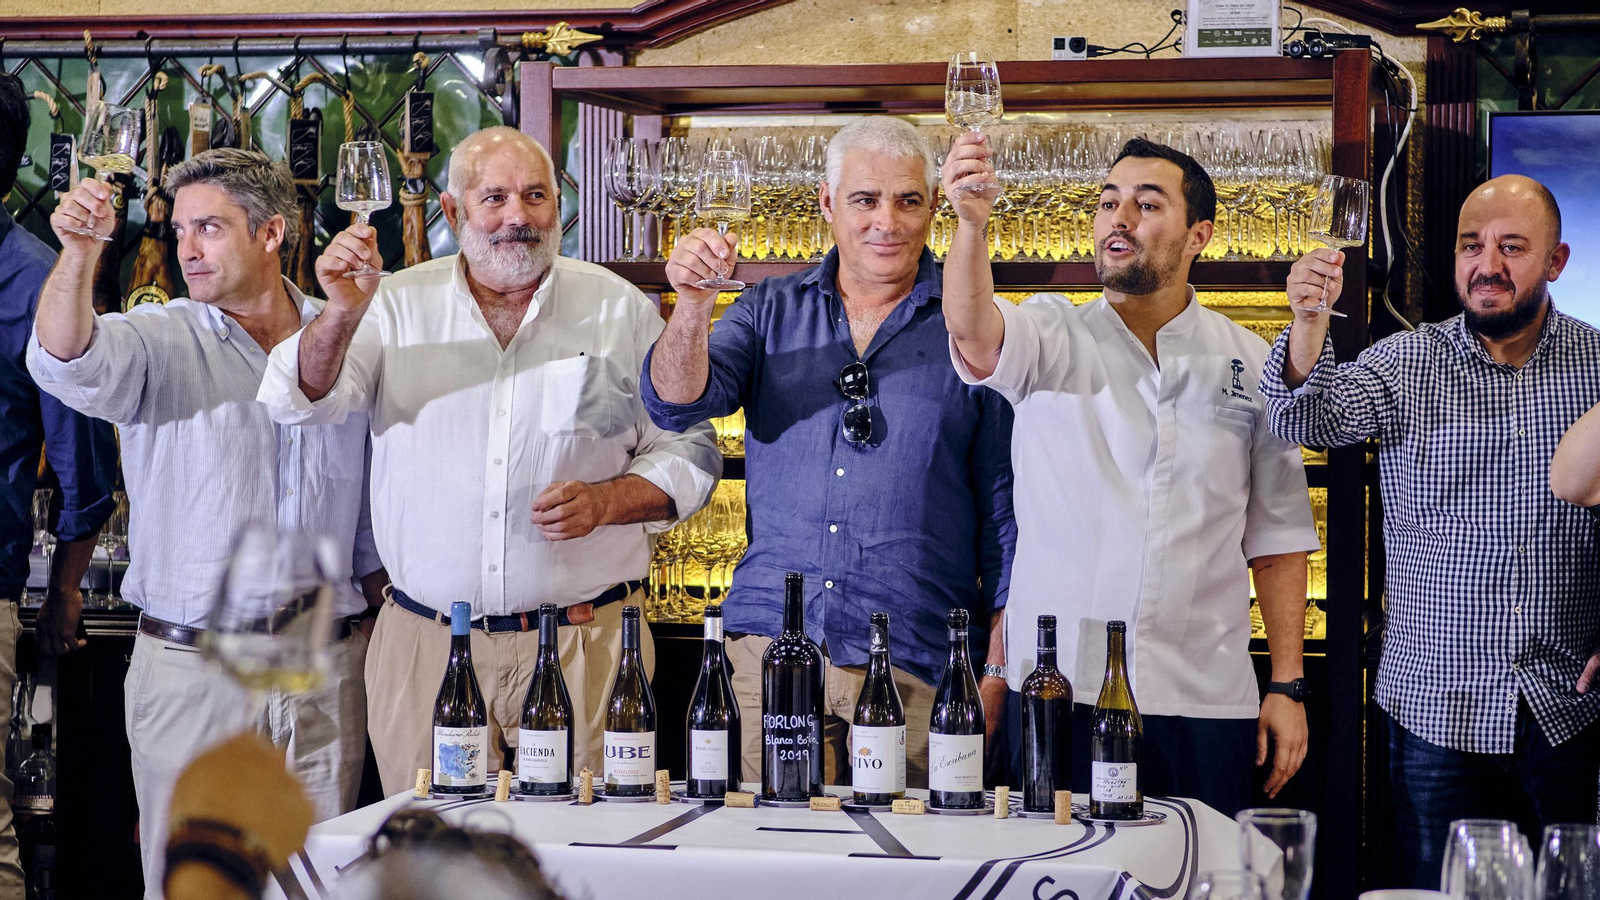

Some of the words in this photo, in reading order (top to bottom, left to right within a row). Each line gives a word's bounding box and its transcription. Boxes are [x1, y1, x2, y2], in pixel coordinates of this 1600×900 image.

[763, 713, 815, 731] FORLONG
[765, 734, 794, 745] Blanco
[605, 744, 651, 759] UBE
[780, 749, 809, 763] 2019
[939, 749, 977, 769] Escribana
